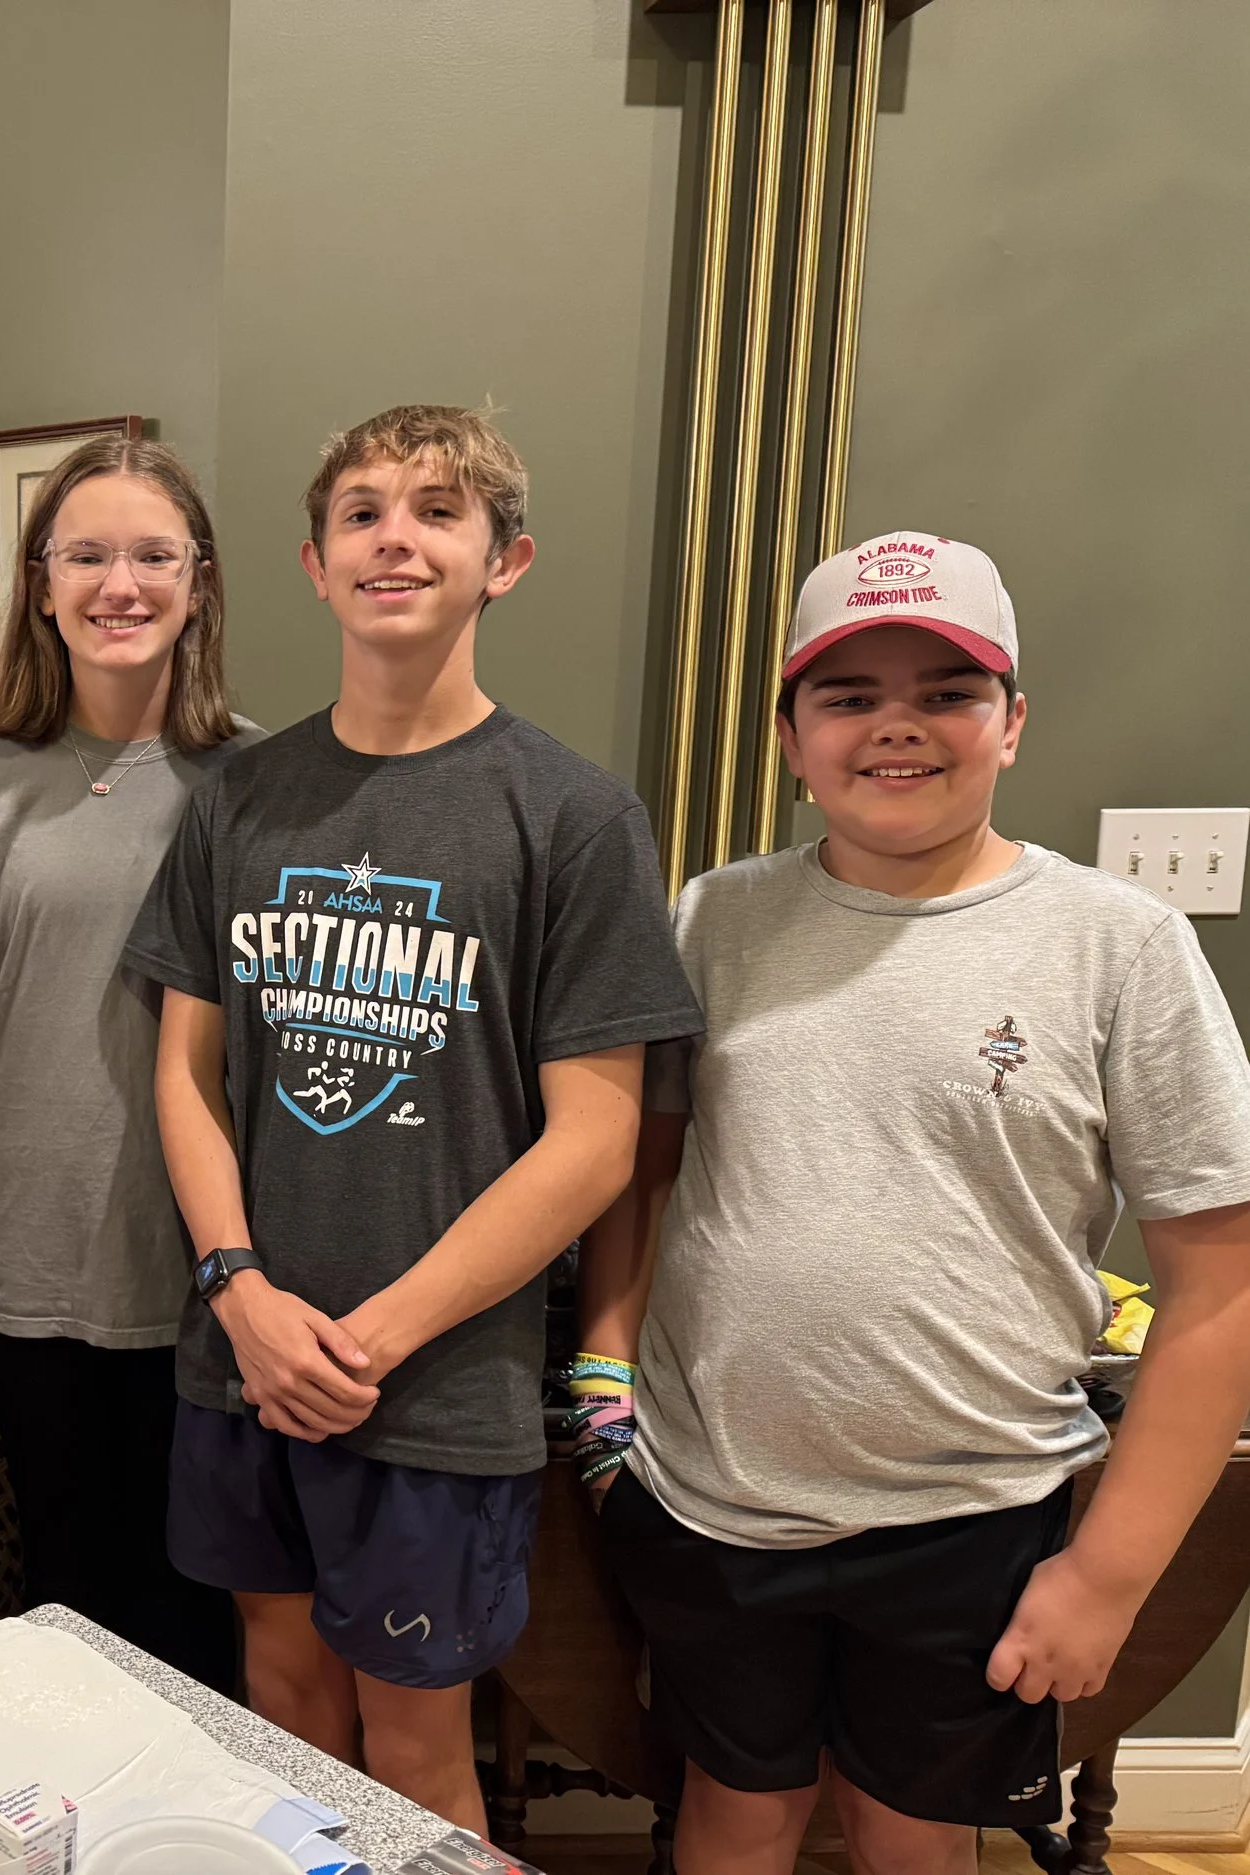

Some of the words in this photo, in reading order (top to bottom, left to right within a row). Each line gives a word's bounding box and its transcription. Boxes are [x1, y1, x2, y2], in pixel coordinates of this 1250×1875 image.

[857, 542, 935, 565] ALABAMA
[878, 564, 915, 578] 1892
[846, 588, 910, 607] CRIMSON
[912, 585, 942, 603] TIDE
[323, 892, 383, 914] AHSAA
[395, 901, 414, 917] 24
[231, 912, 480, 1012] SECTIONAL
[260, 987, 448, 1048] CHMPIONSHIPS
[326, 1038, 412, 1069] COUNTRY
[942, 1080, 998, 1100] CROWN
[443, 1838, 507, 1867] Energizer
